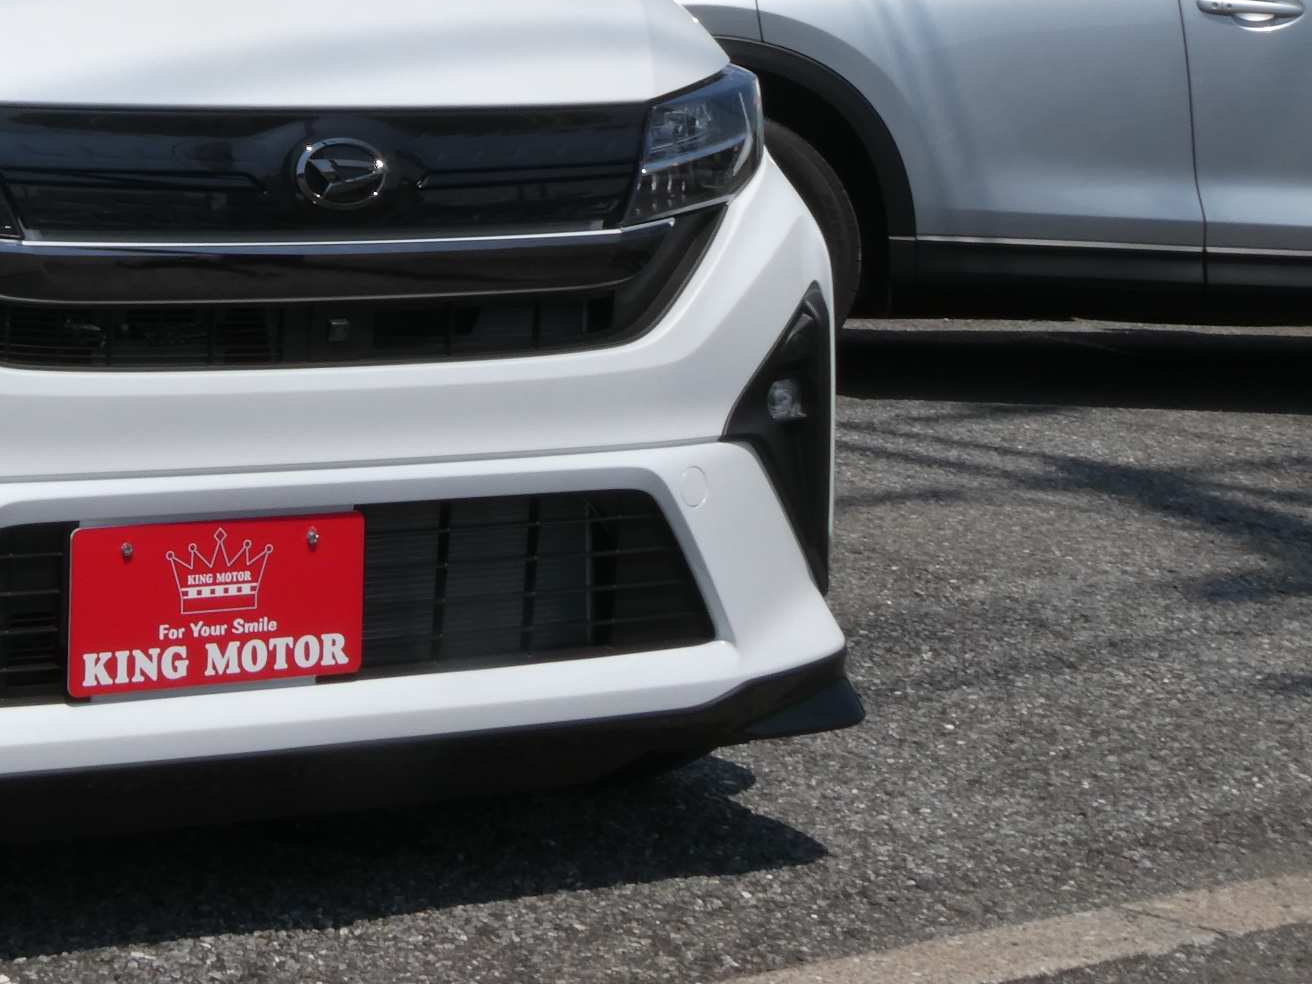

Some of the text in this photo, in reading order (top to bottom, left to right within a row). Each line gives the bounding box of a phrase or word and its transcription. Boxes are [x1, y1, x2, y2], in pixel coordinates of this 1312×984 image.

[187, 570, 252, 586] KING MOTOR
[159, 617, 278, 641] For Your Smile
[82, 632, 350, 688] KING MOTOR
